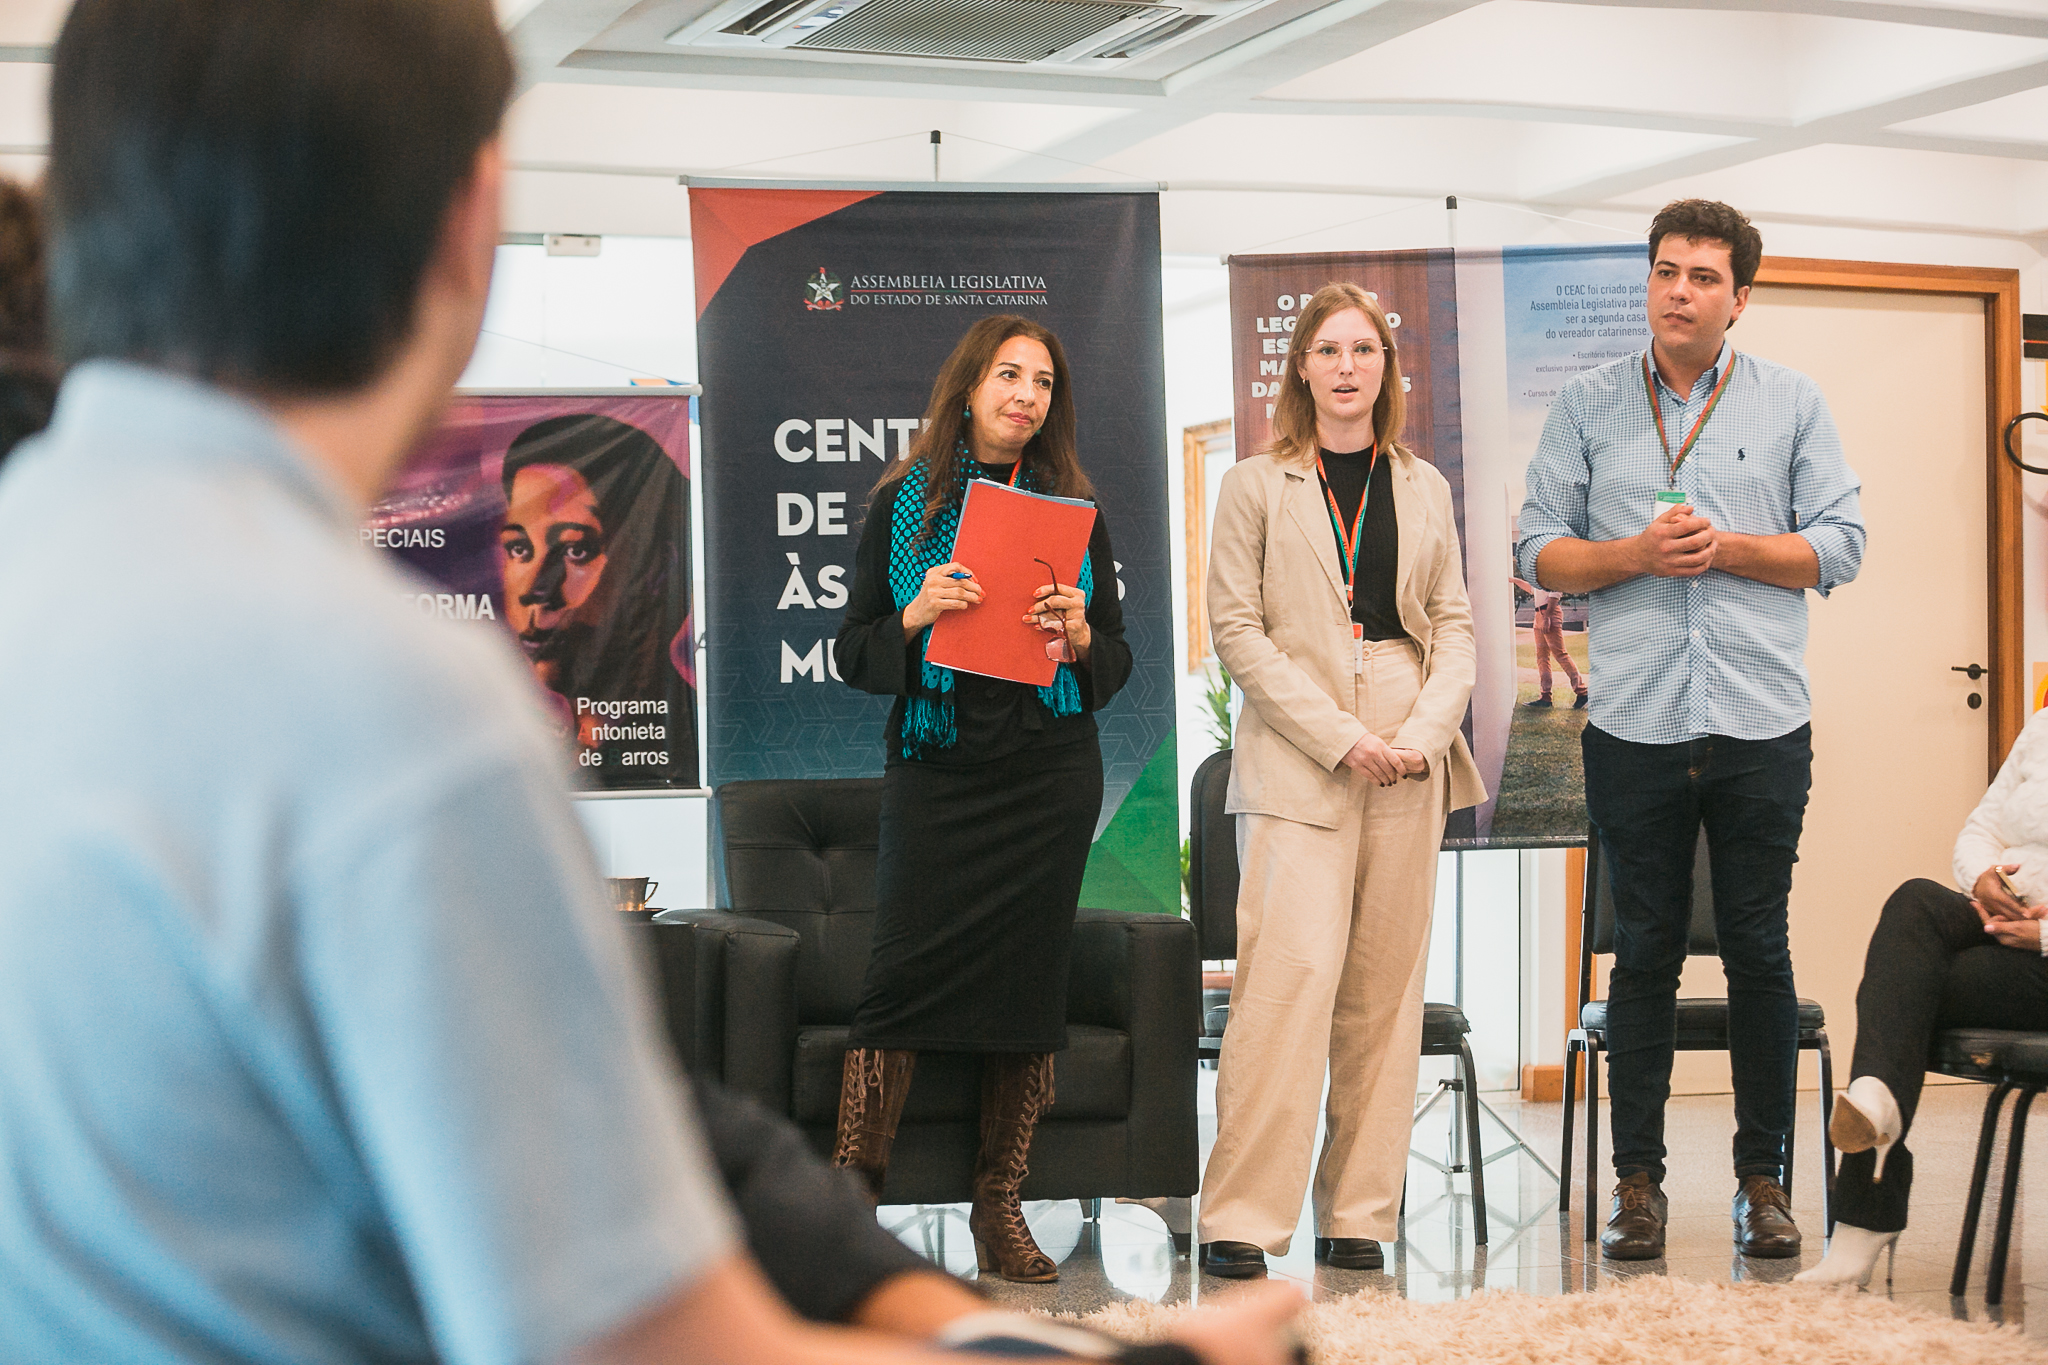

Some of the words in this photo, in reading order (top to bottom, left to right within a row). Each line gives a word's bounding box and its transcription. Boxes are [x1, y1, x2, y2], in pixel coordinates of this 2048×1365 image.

[850, 275, 946, 289] ASSEMBLEIA
[950, 275, 1047, 289] LEGISLATIVA
[1556, 285, 1562, 296] O
[1564, 285, 1586, 296] CEAC
[1587, 284, 1599, 295] foi
[1600, 283, 1627, 295] criado
[1629, 283, 1648, 296] pela
[850, 294, 870, 305] DO
[874, 294, 921, 305] ESTADO
[925, 294, 941, 305] DE
[944, 294, 984, 305] SANTA
[986, 294, 1048, 305] CATARINA
[1277, 294, 1295, 311] O
[1530, 299, 1579, 312] Assembleia
[1581, 298, 1627, 311] Legislativa
[1629, 299, 1647, 310] para
[1565, 316, 1578, 324] ser
[1581, 315, 1586, 324] a
[1588, 313, 1625, 325] segunda
[1626, 313, 1646, 322] casa
[1545, 329, 1556, 339] do
[1558, 327, 1595, 338] vereador
[1597, 326, 1650, 337] catarinense.
[1577, 351, 1606, 359] Escritório
[1535, 364, 1563, 373] exclusivo
[1564, 365, 1578, 373] para
[1528, 389, 1548, 398] Cursos
[1549, 389, 1557, 397] de
[774, 418, 933, 463] CENT
[776, 491, 848, 536] DE
[352, 528, 446, 549] PECIAIS
[776, 552, 849, 610] ÀS
[402, 593, 496, 620] ORMA
[576, 697, 669, 720] Programa
[579, 748, 602, 767] de
